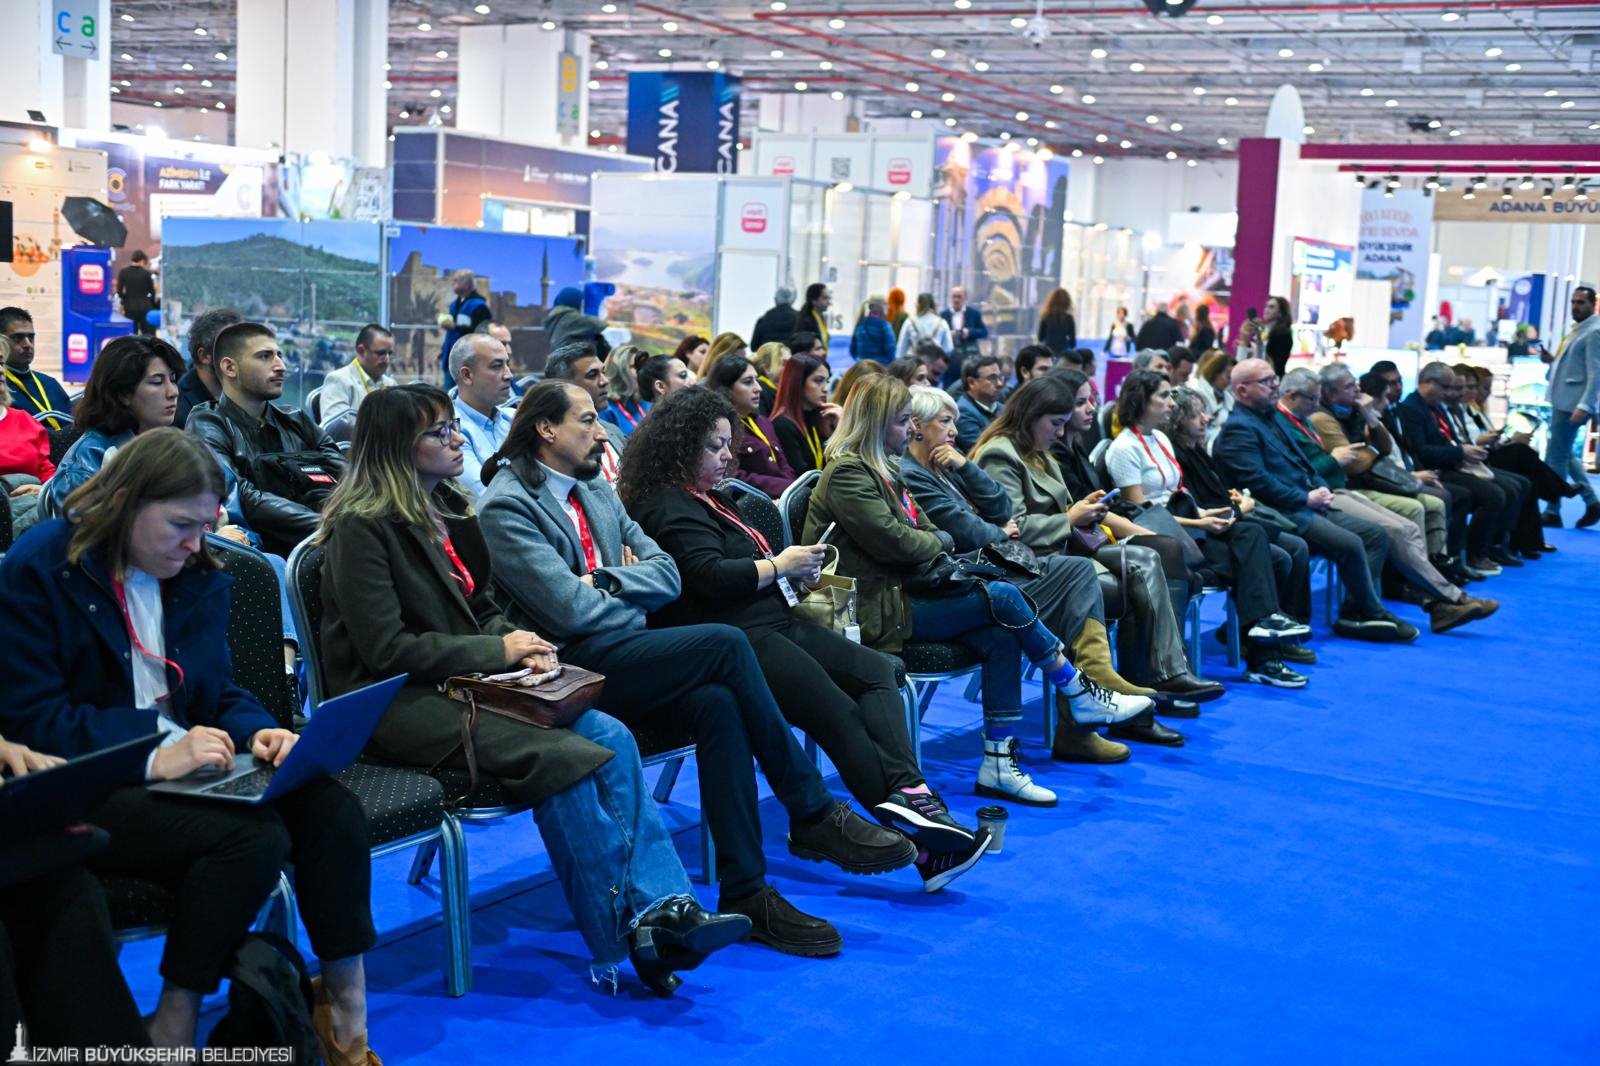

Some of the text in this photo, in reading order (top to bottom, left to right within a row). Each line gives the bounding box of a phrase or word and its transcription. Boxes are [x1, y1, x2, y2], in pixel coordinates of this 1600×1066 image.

[57, 11, 95, 37] c a
[1489, 199, 1600, 213] ADANA BÜYÜ
[1364, 253, 1402, 263] ADANA
